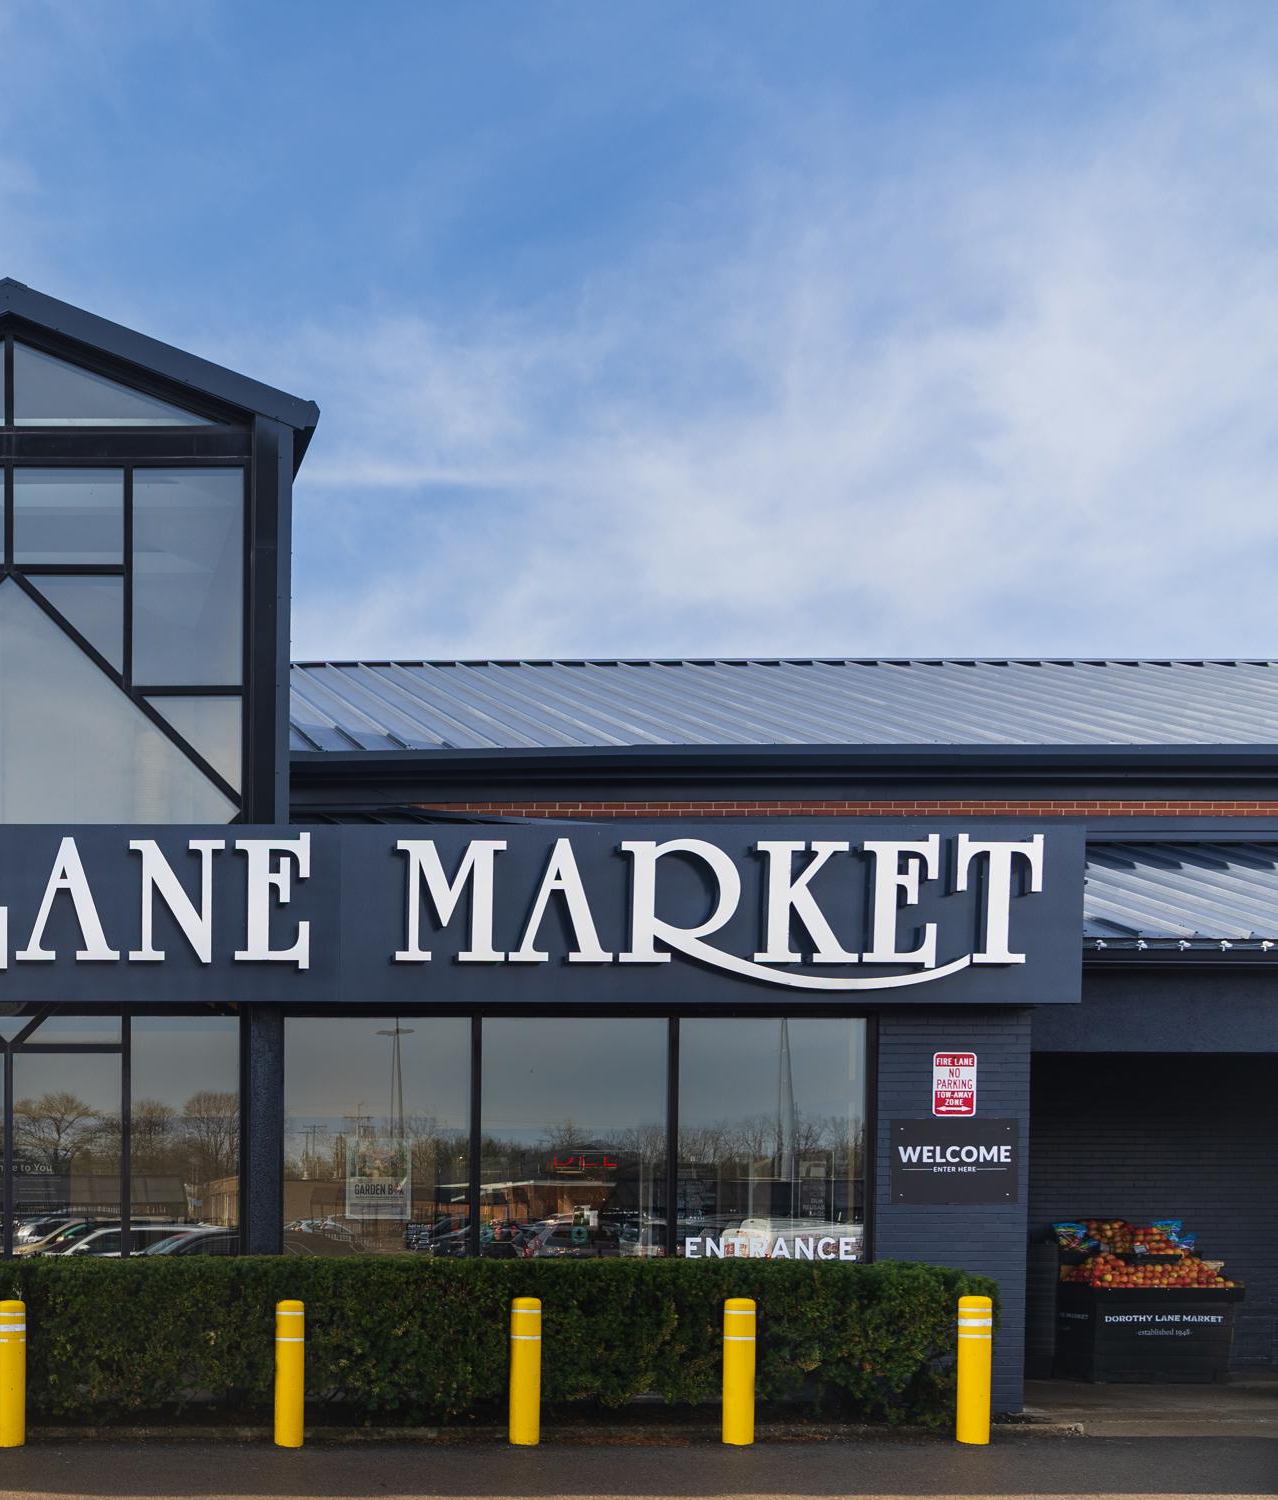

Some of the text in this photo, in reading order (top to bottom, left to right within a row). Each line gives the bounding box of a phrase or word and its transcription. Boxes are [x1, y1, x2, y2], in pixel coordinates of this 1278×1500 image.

[395, 832, 1043, 991] MARKET
[936, 1057, 974, 1066] FIRE LANE
[948, 1067, 961, 1078] NO
[936, 1079, 973, 1090] PARKING
[936, 1091, 973, 1099] TOW-AWAY
[944, 1098, 964, 1106] ZONE
[898, 1145, 1012, 1163] WELCOME
[21, 1163, 31, 1172] to
[33, 1163, 53, 1172] You
[354, 1183, 386, 1196] GARDEN
[685, 1237, 857, 1261] ENTRANCE
[1104, 1314, 1224, 1323] DOROTHY LANE MARKET
